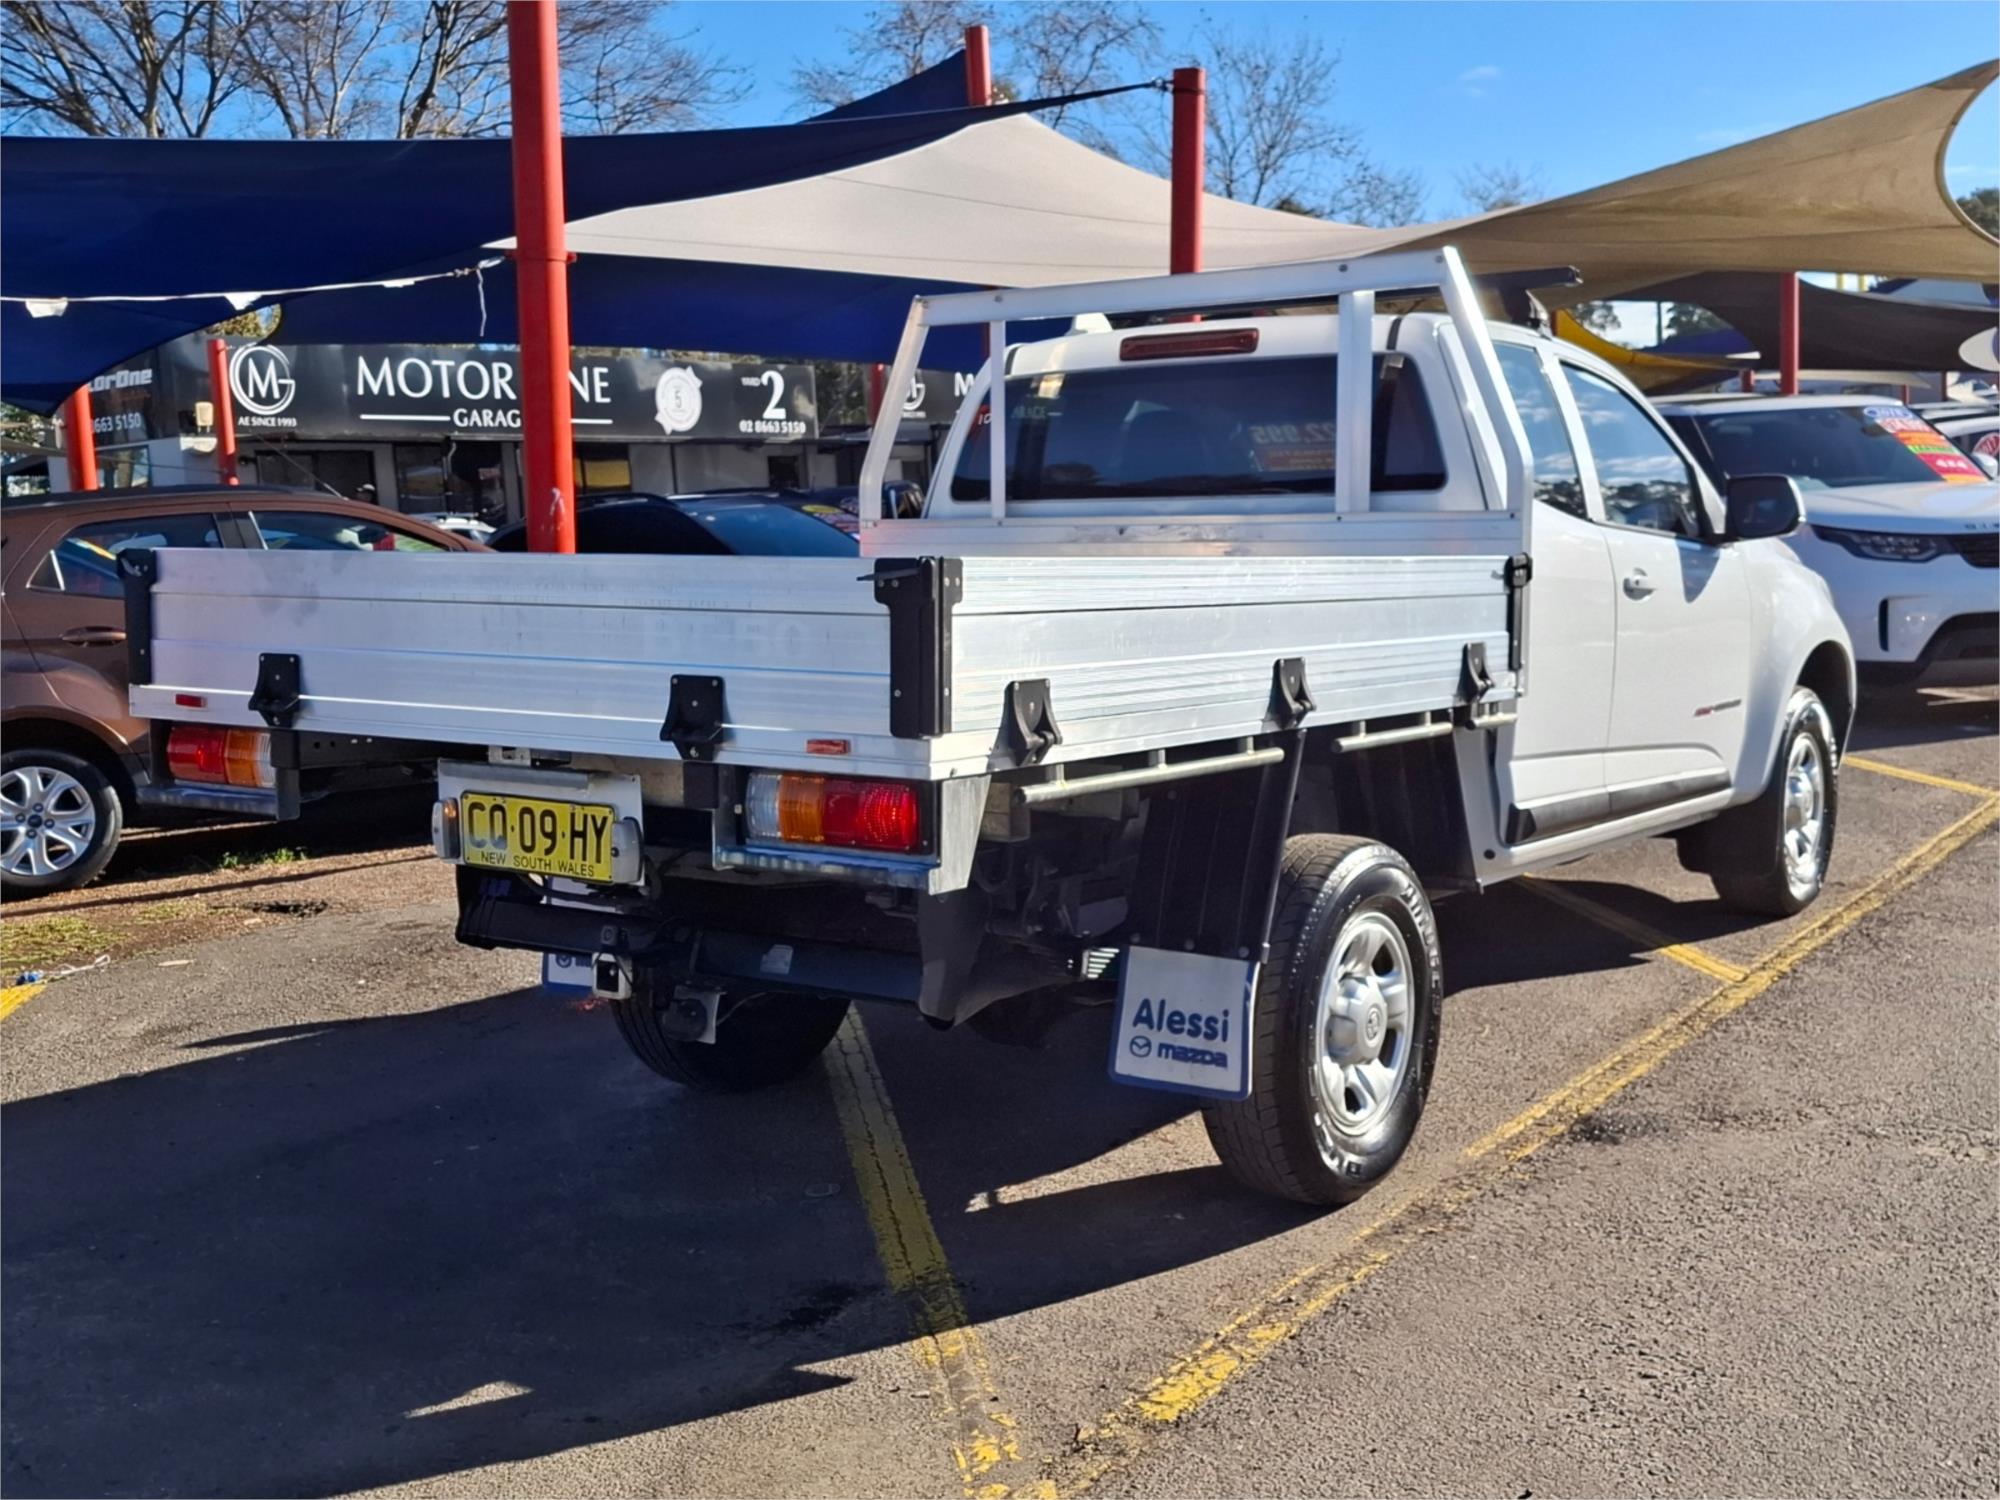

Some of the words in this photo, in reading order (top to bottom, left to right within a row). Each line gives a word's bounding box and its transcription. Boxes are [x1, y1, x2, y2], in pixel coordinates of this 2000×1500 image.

[357, 355, 612, 403] MOTORNE
[760, 369, 787, 420] 2
[92, 416, 113, 433] 663
[115, 412, 141, 431] 5150
[453, 408, 521, 428] GARAG
[481, 851, 506, 865] NEW
[513, 855, 551, 869] SOUTH
[558, 862, 595, 877] WALES
[1132, 998, 1230, 1042] Alessi
